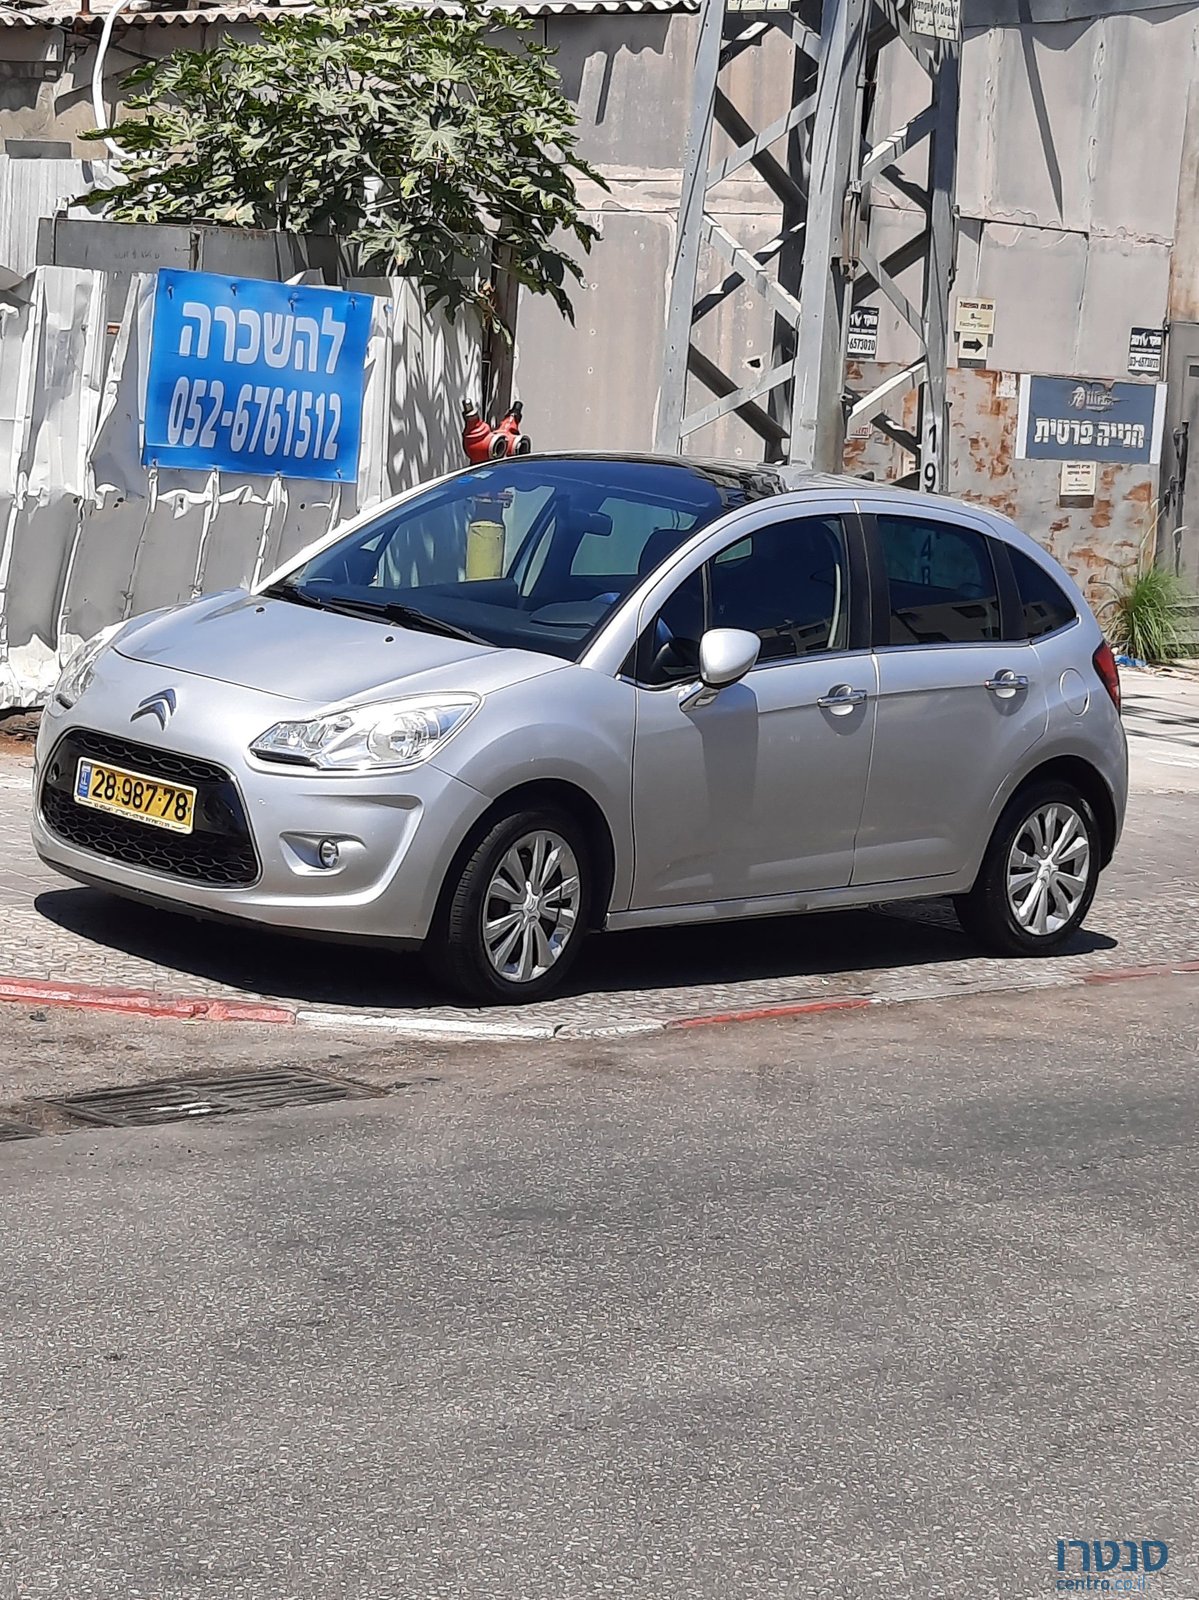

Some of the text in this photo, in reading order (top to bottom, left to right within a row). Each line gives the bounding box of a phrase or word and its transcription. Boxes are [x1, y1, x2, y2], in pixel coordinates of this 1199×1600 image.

[178, 302, 346, 375] להשכרה
[167, 375, 341, 460] 052-6761512
[1034, 417, 1145, 448] חנייה פרטית
